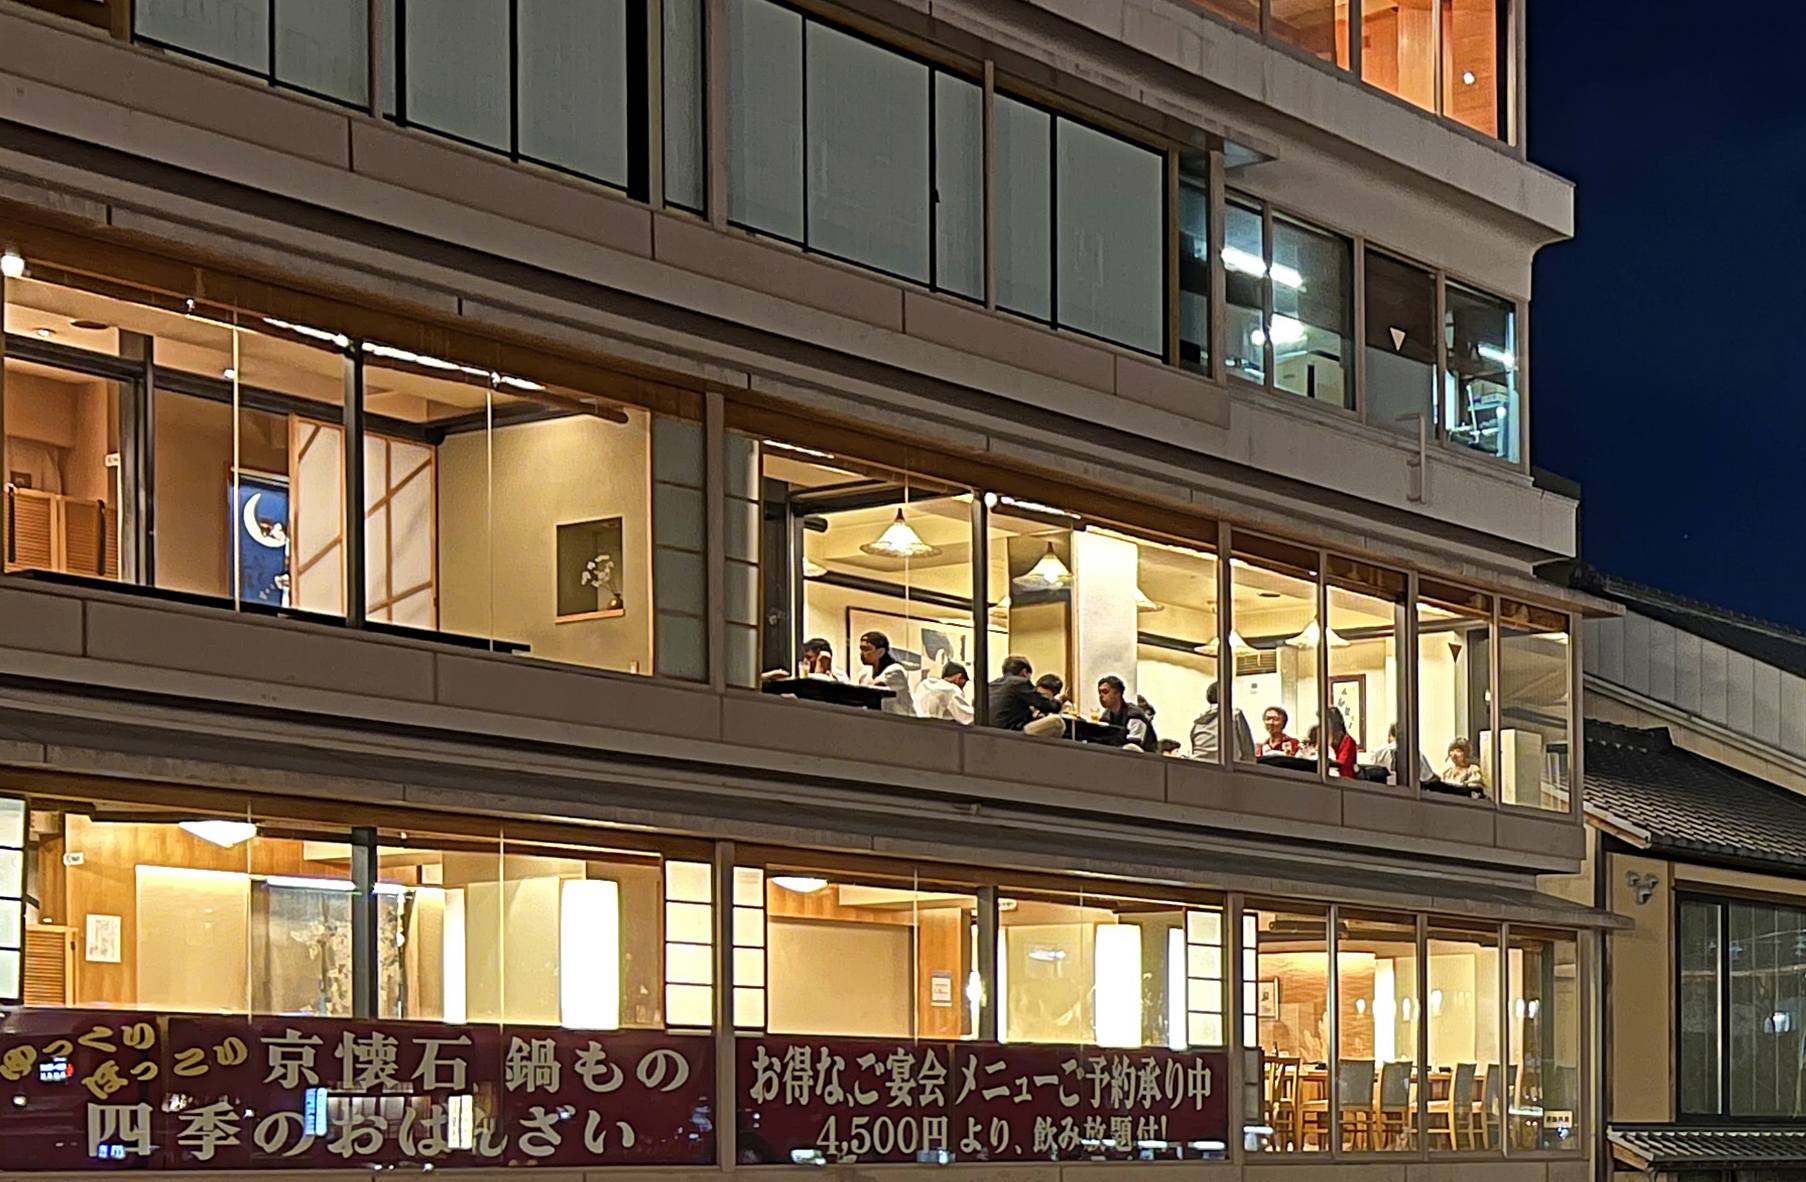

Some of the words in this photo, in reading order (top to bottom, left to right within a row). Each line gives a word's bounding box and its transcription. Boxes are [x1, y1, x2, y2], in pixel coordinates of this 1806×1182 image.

[0, 1022, 156, 1081] ゆっくり
[81, 1036, 249, 1099] ほっこり
[505, 1034, 690, 1093] 鍋もの
